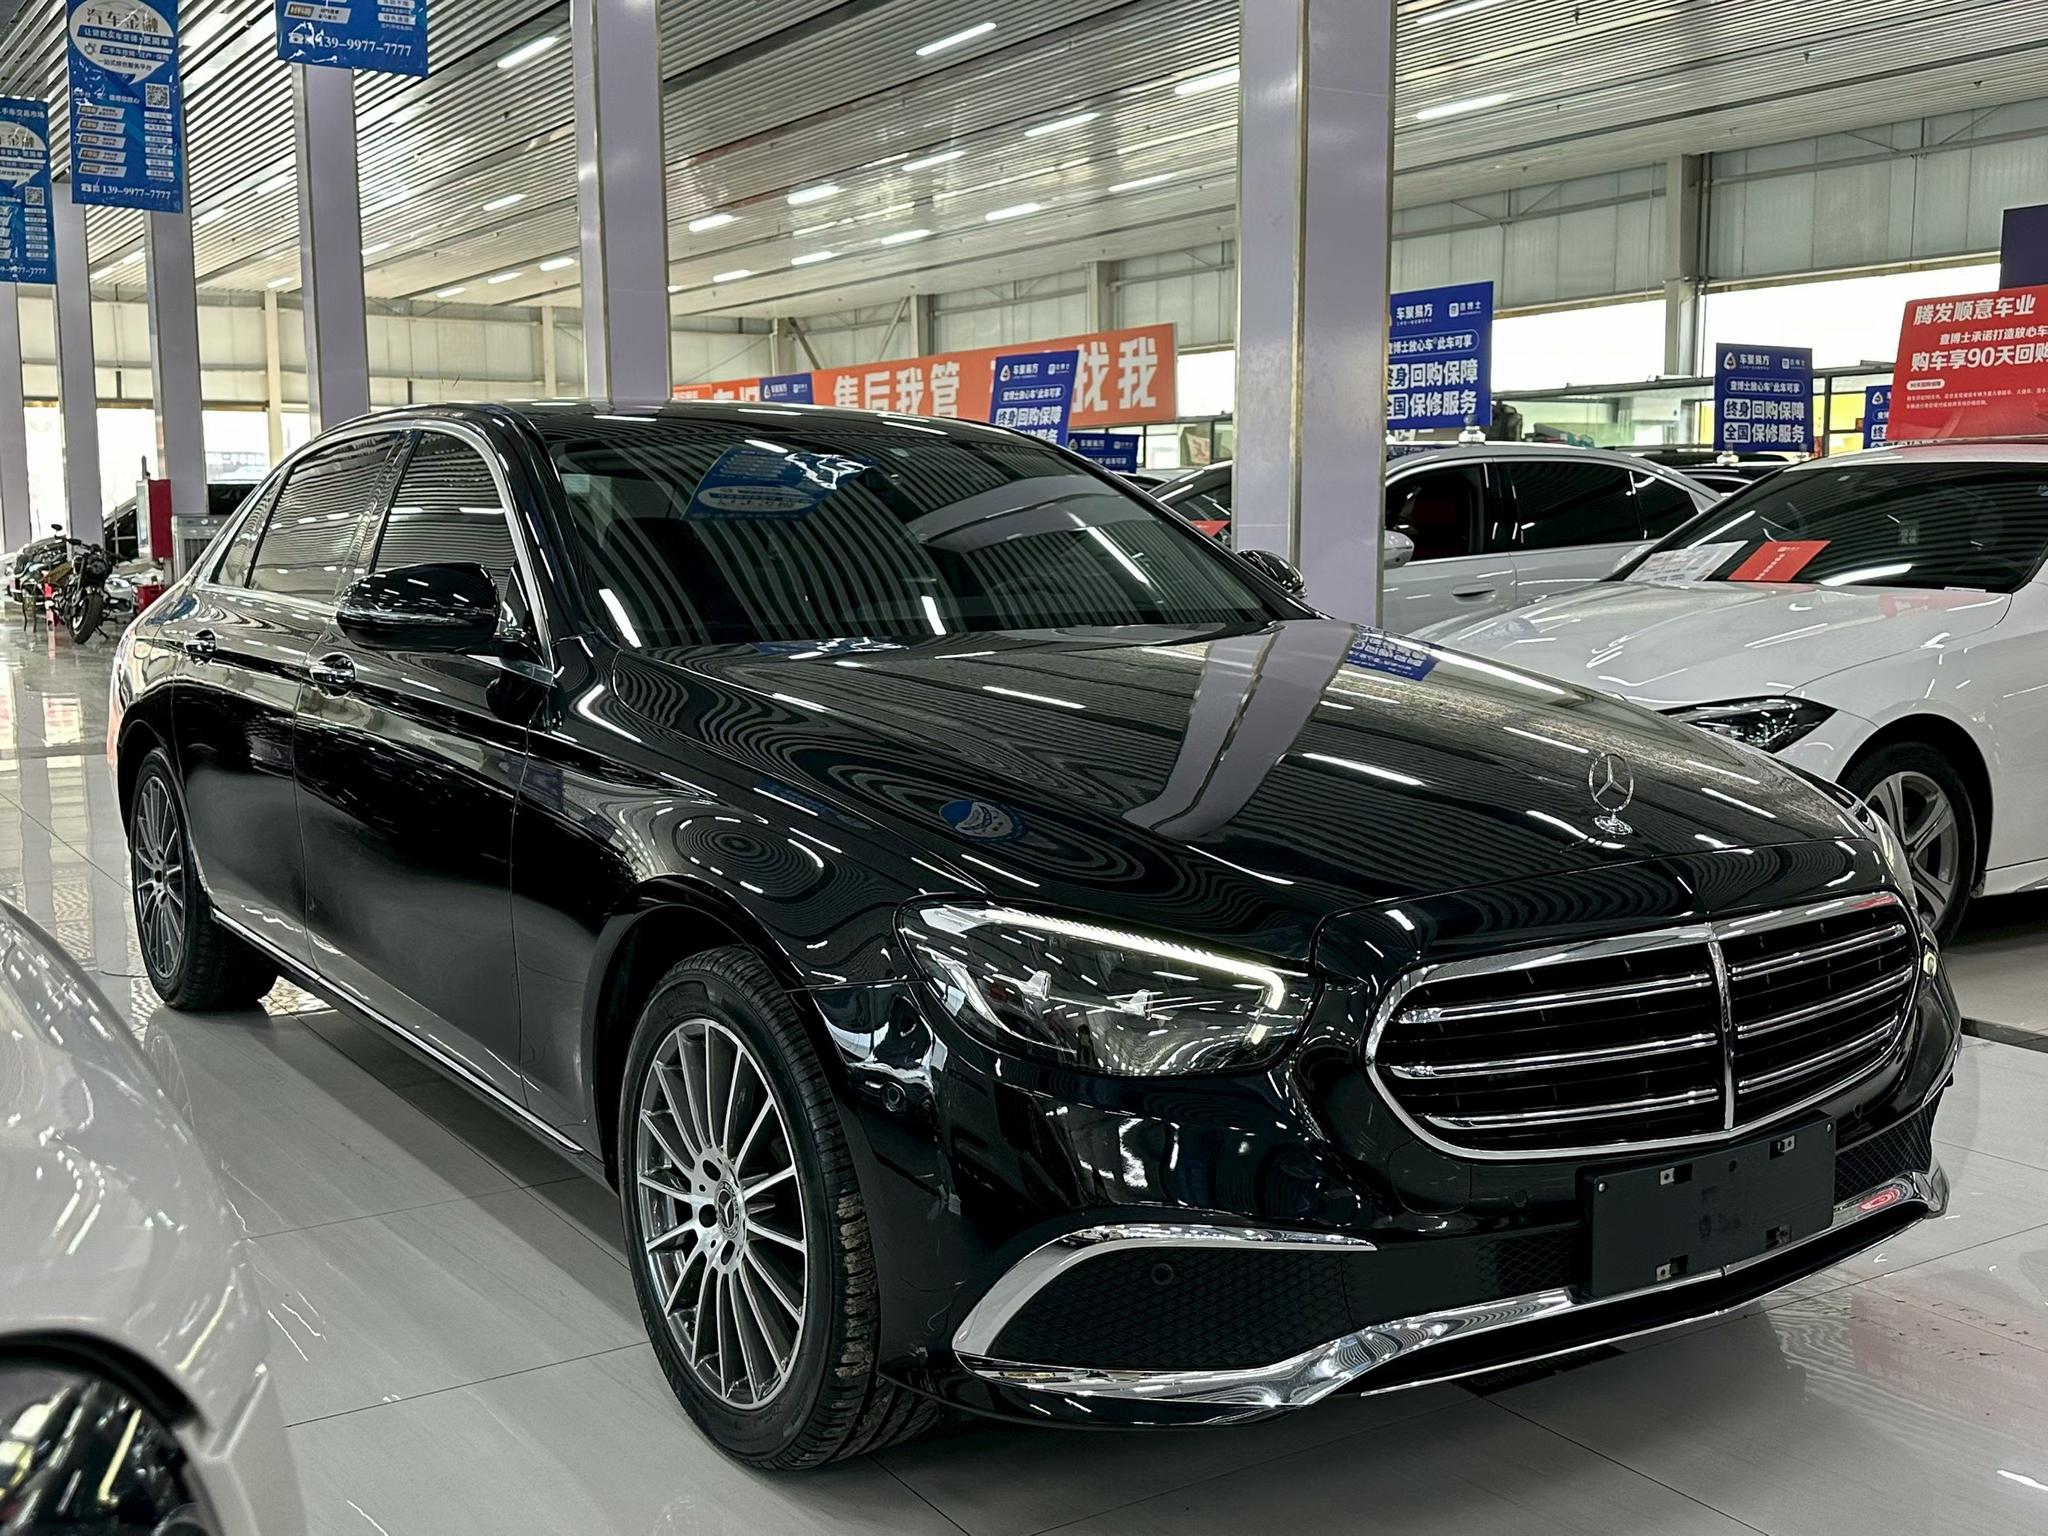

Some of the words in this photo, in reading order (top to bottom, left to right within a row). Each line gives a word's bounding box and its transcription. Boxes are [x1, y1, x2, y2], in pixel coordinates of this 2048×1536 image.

[102, 184, 171, 200] 139-9977-7777
[1912, 294, 2036, 326] 腾发顺意车业
[1939, 325, 2048, 346] 查博士承诺打造放心车
[1910, 343, 2048, 373] 购车享90天回购
[833, 361, 960, 416] 售后我管
